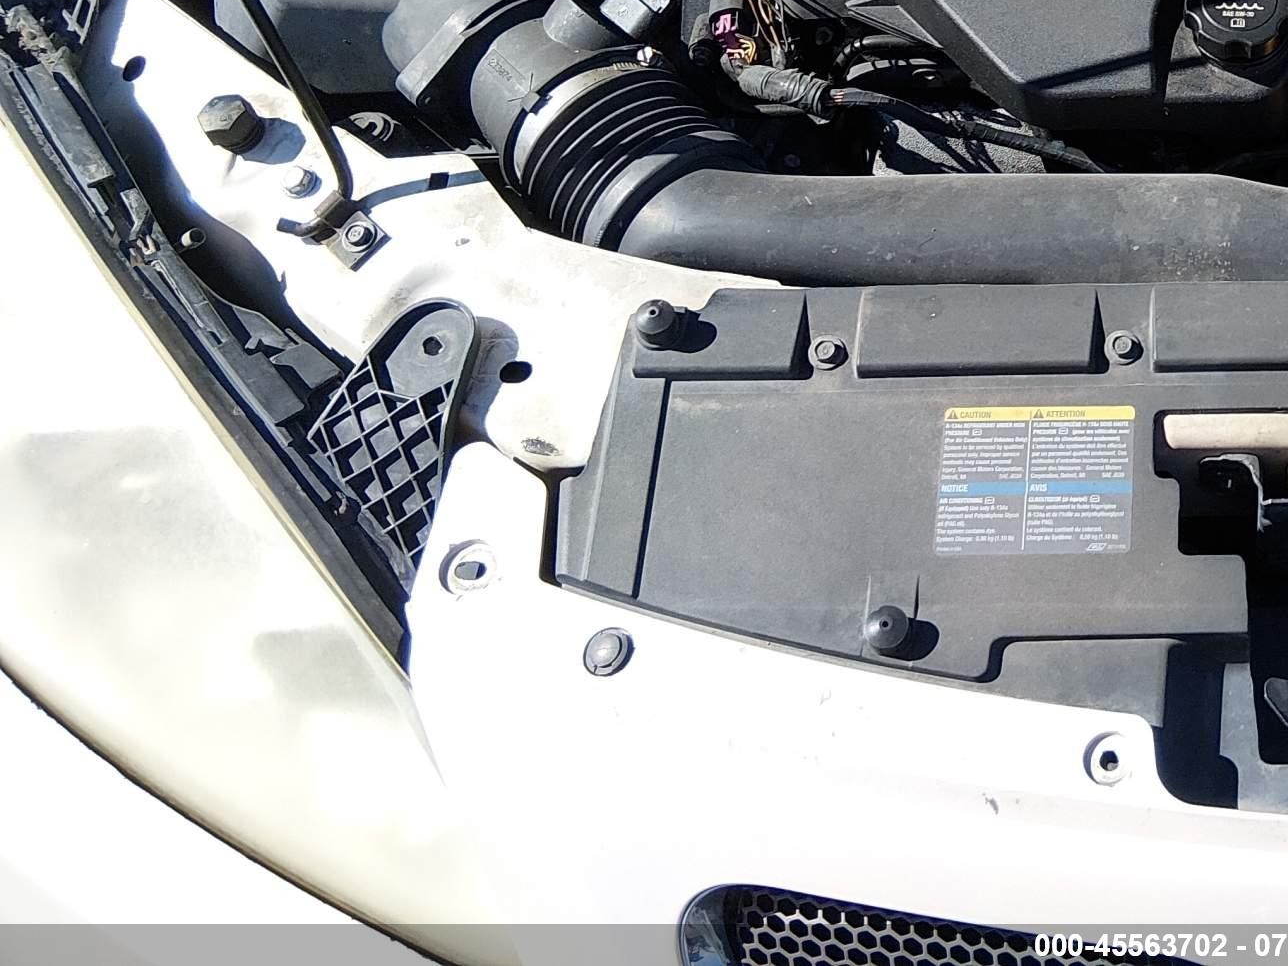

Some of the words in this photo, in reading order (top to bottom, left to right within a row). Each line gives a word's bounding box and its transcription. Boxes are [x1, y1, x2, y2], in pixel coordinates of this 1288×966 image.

[960, 411, 992, 419] CAUTION
[941, 484, 969, 492] NOTICE
[1029, 483, 1048, 492] AVIS
